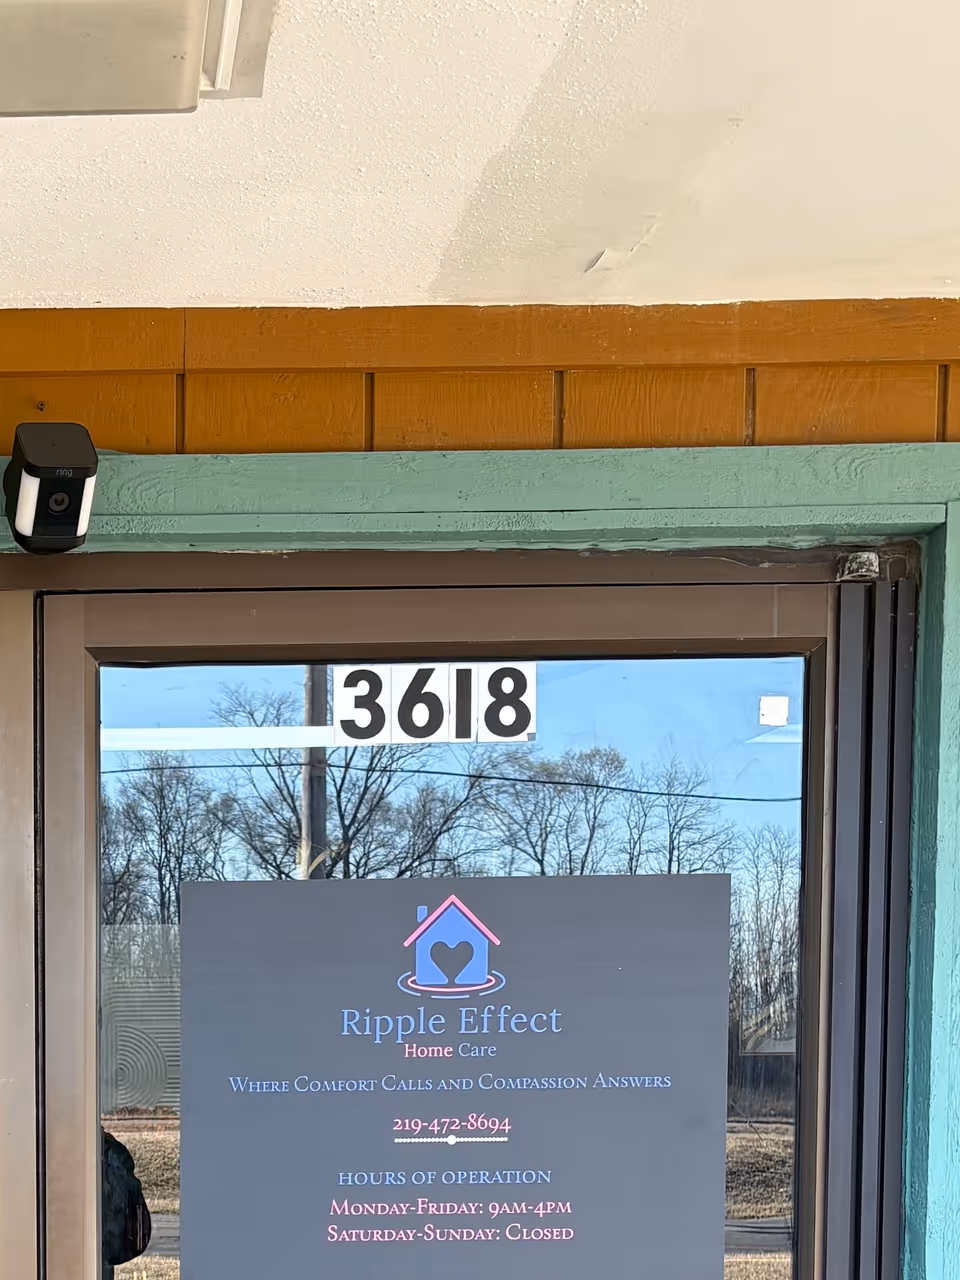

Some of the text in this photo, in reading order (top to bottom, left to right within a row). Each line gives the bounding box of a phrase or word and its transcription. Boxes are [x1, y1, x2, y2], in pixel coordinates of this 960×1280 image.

[55, 467, 73, 478] ring
[340, 667, 532, 740] 3618
[341, 1003, 563, 1044] Ripple Effect
[403, 1042, 497, 1059] Home Care
[228, 1072, 672, 1093] WHERE COMFORT CALLS AND COMPASSION ANSWERS
[392, 1112, 512, 1134] 219-472-8694
[337, 1169, 552, 1187] HOURS OF OPERATION
[329, 1198, 573, 1219] MONDAY-FRIDAY: 9AM-4PM
[327, 1222, 575, 1243] SATURDAY-SUNDAY: CLOSED
